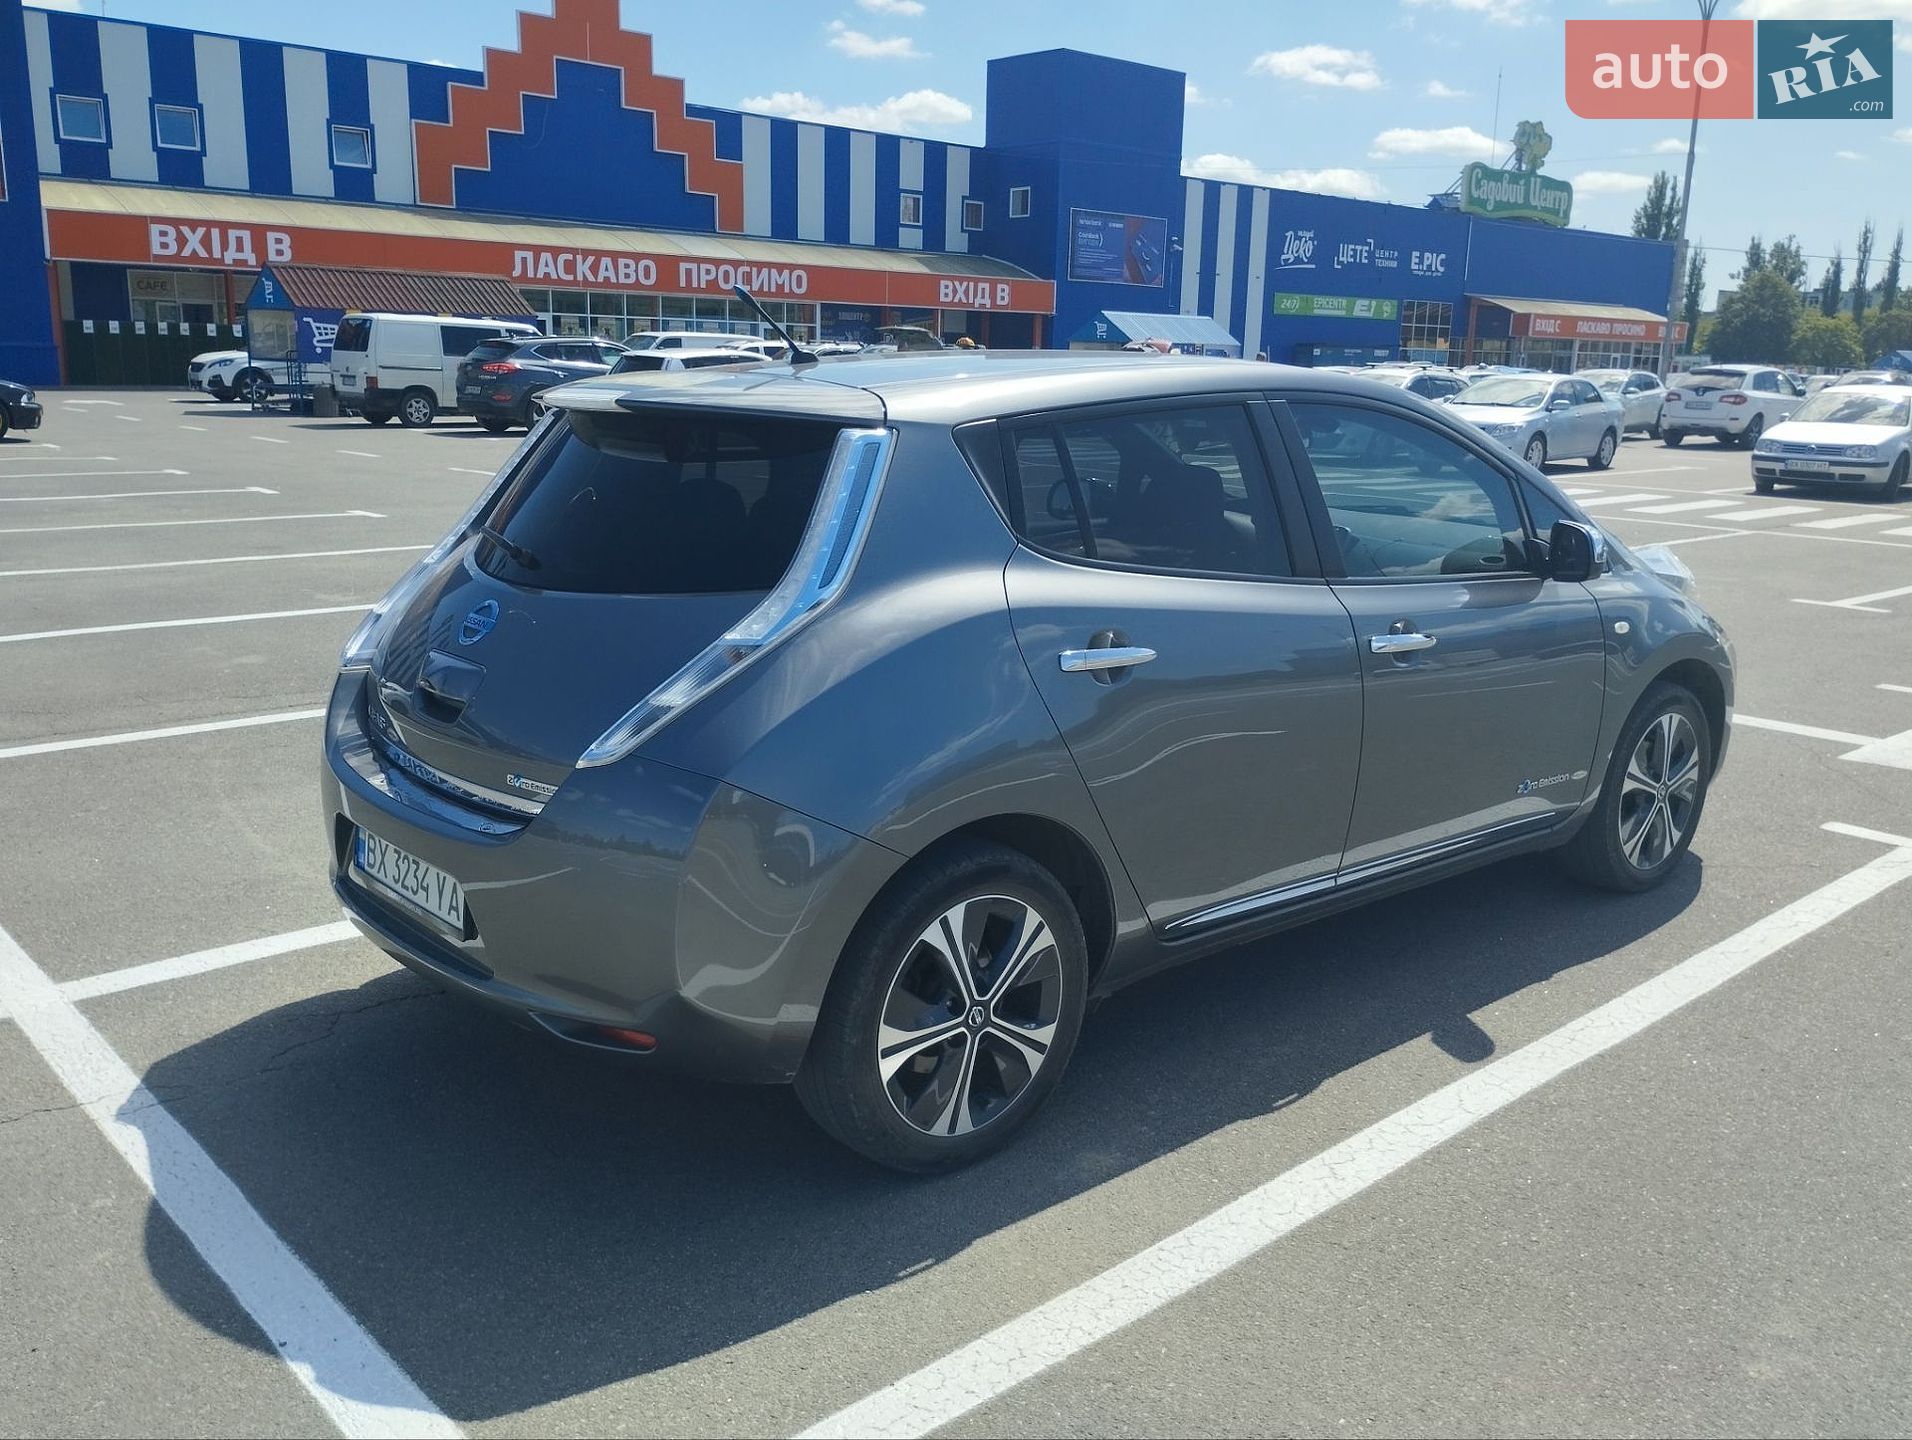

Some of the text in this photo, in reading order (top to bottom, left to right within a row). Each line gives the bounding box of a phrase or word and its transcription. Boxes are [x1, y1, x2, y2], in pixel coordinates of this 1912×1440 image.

[1529, 177, 1569, 217] Центр
[151, 223, 256, 267] ВХІД
[513, 250, 808, 295] ЛАСКАВО ПРОСИМО
[939, 280, 991, 308] ВХІД
[366, 833, 389, 879] BX
[392, 847, 430, 904] 3234
[436, 871, 461, 922] YA
